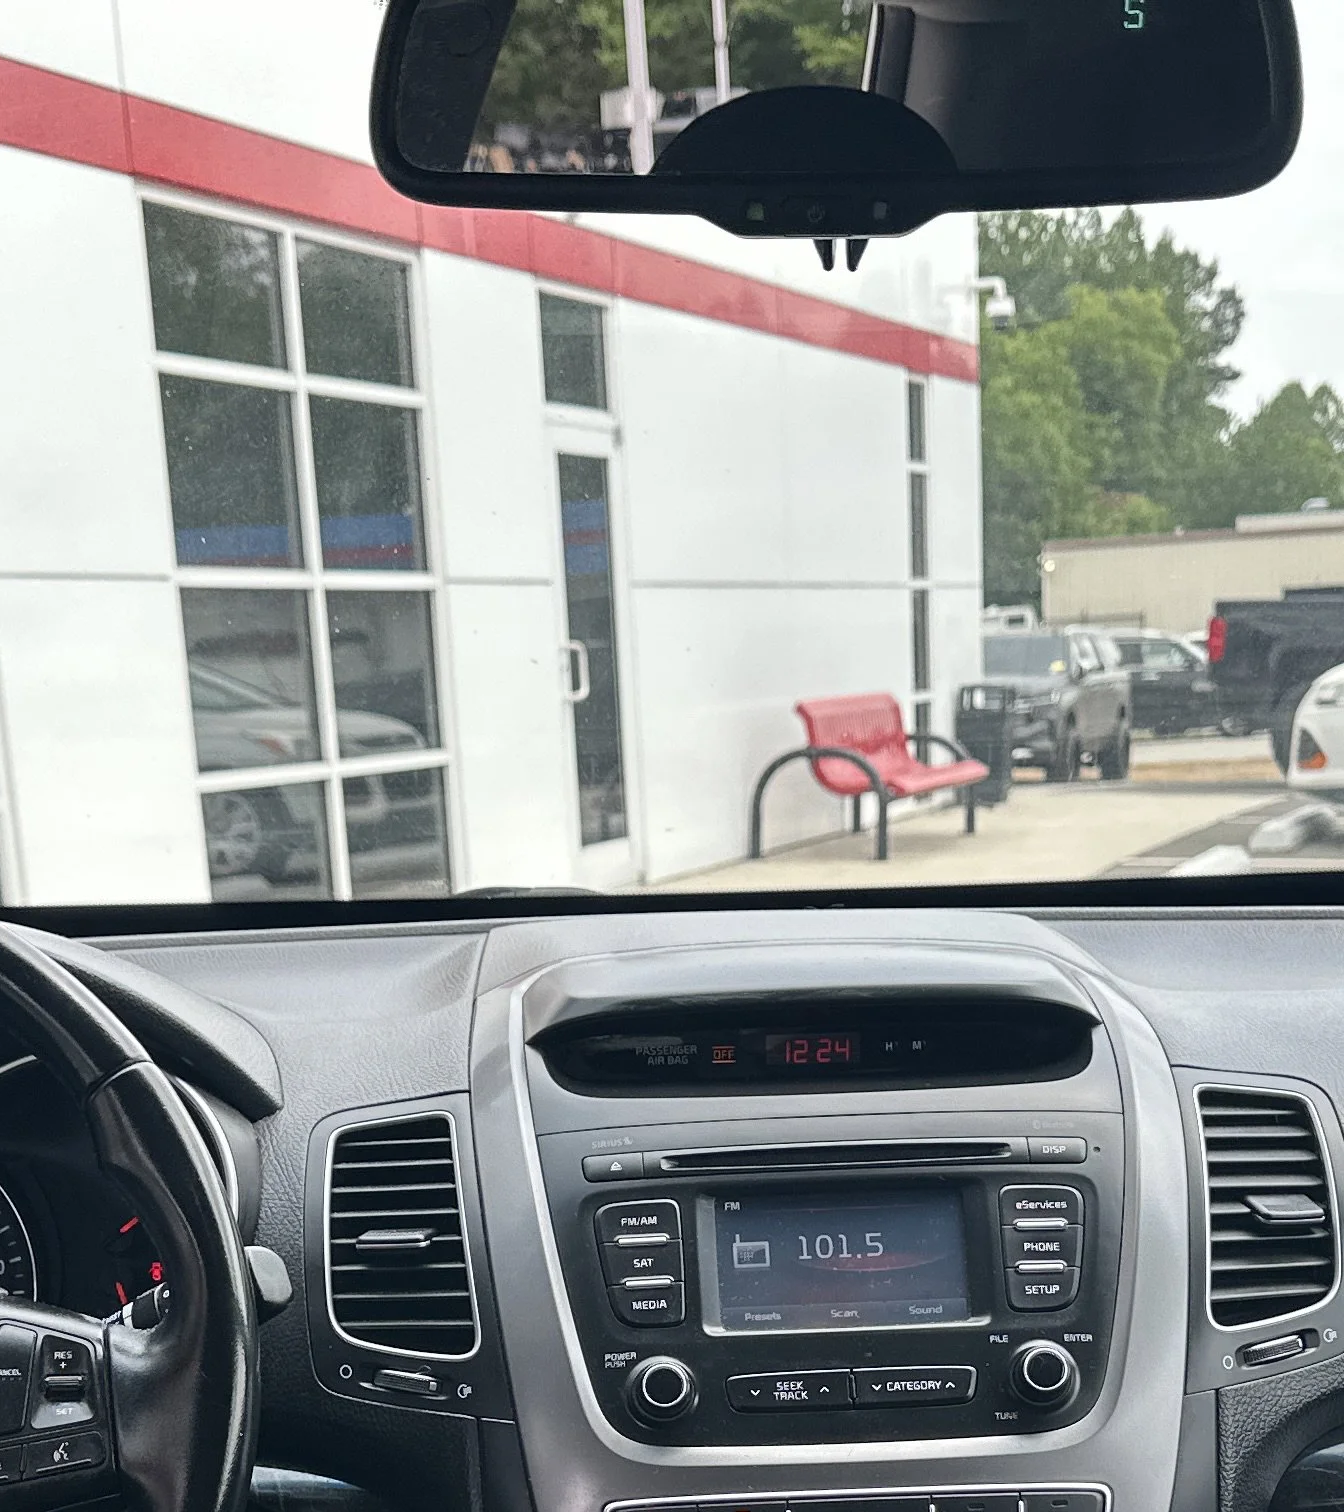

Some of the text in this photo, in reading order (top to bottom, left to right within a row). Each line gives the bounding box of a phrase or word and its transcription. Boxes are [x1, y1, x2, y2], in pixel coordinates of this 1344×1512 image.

[635, 1045, 698, 1056] PASSENGER
[713, 1050, 735, 1060] OFF
[647, 1055, 689, 1065] AIR BAG
[1042, 1145, 1067, 1154] DISP
[724, 1201, 741, 1211] FM
[1015, 1200, 1068, 1210] eServices
[621, 1215, 658, 1227] FM/AM
[798, 1232, 885, 1260] 101.5
[1023, 1242, 1061, 1251] PHONE
[633, 1258, 654, 1268] SAT
[1024, 1285, 1060, 1295] SETUP
[631, 1299, 668, 1310] MEDIA
[908, 1304, 944, 1315] Sound
[744, 1311, 782, 1322] Presets
[830, 1308, 859, 1318] Scan
[989, 1334, 1009, 1343] FILE
[1063, 1333, 1093, 1343] ENTER
[54, 1350, 73, 1360] RES
[604, 1351, 637, 1362] POWER
[605, 1360, 626, 1369] PUSH
[776, 1380, 804, 1391] SEEK
[886, 1380, 942, 1392] CATEGORY
[773, 1390, 809, 1401] TRACK
[56, 1407, 73, 1416] SET
[994, 1411, 1019, 1421] TUNE
